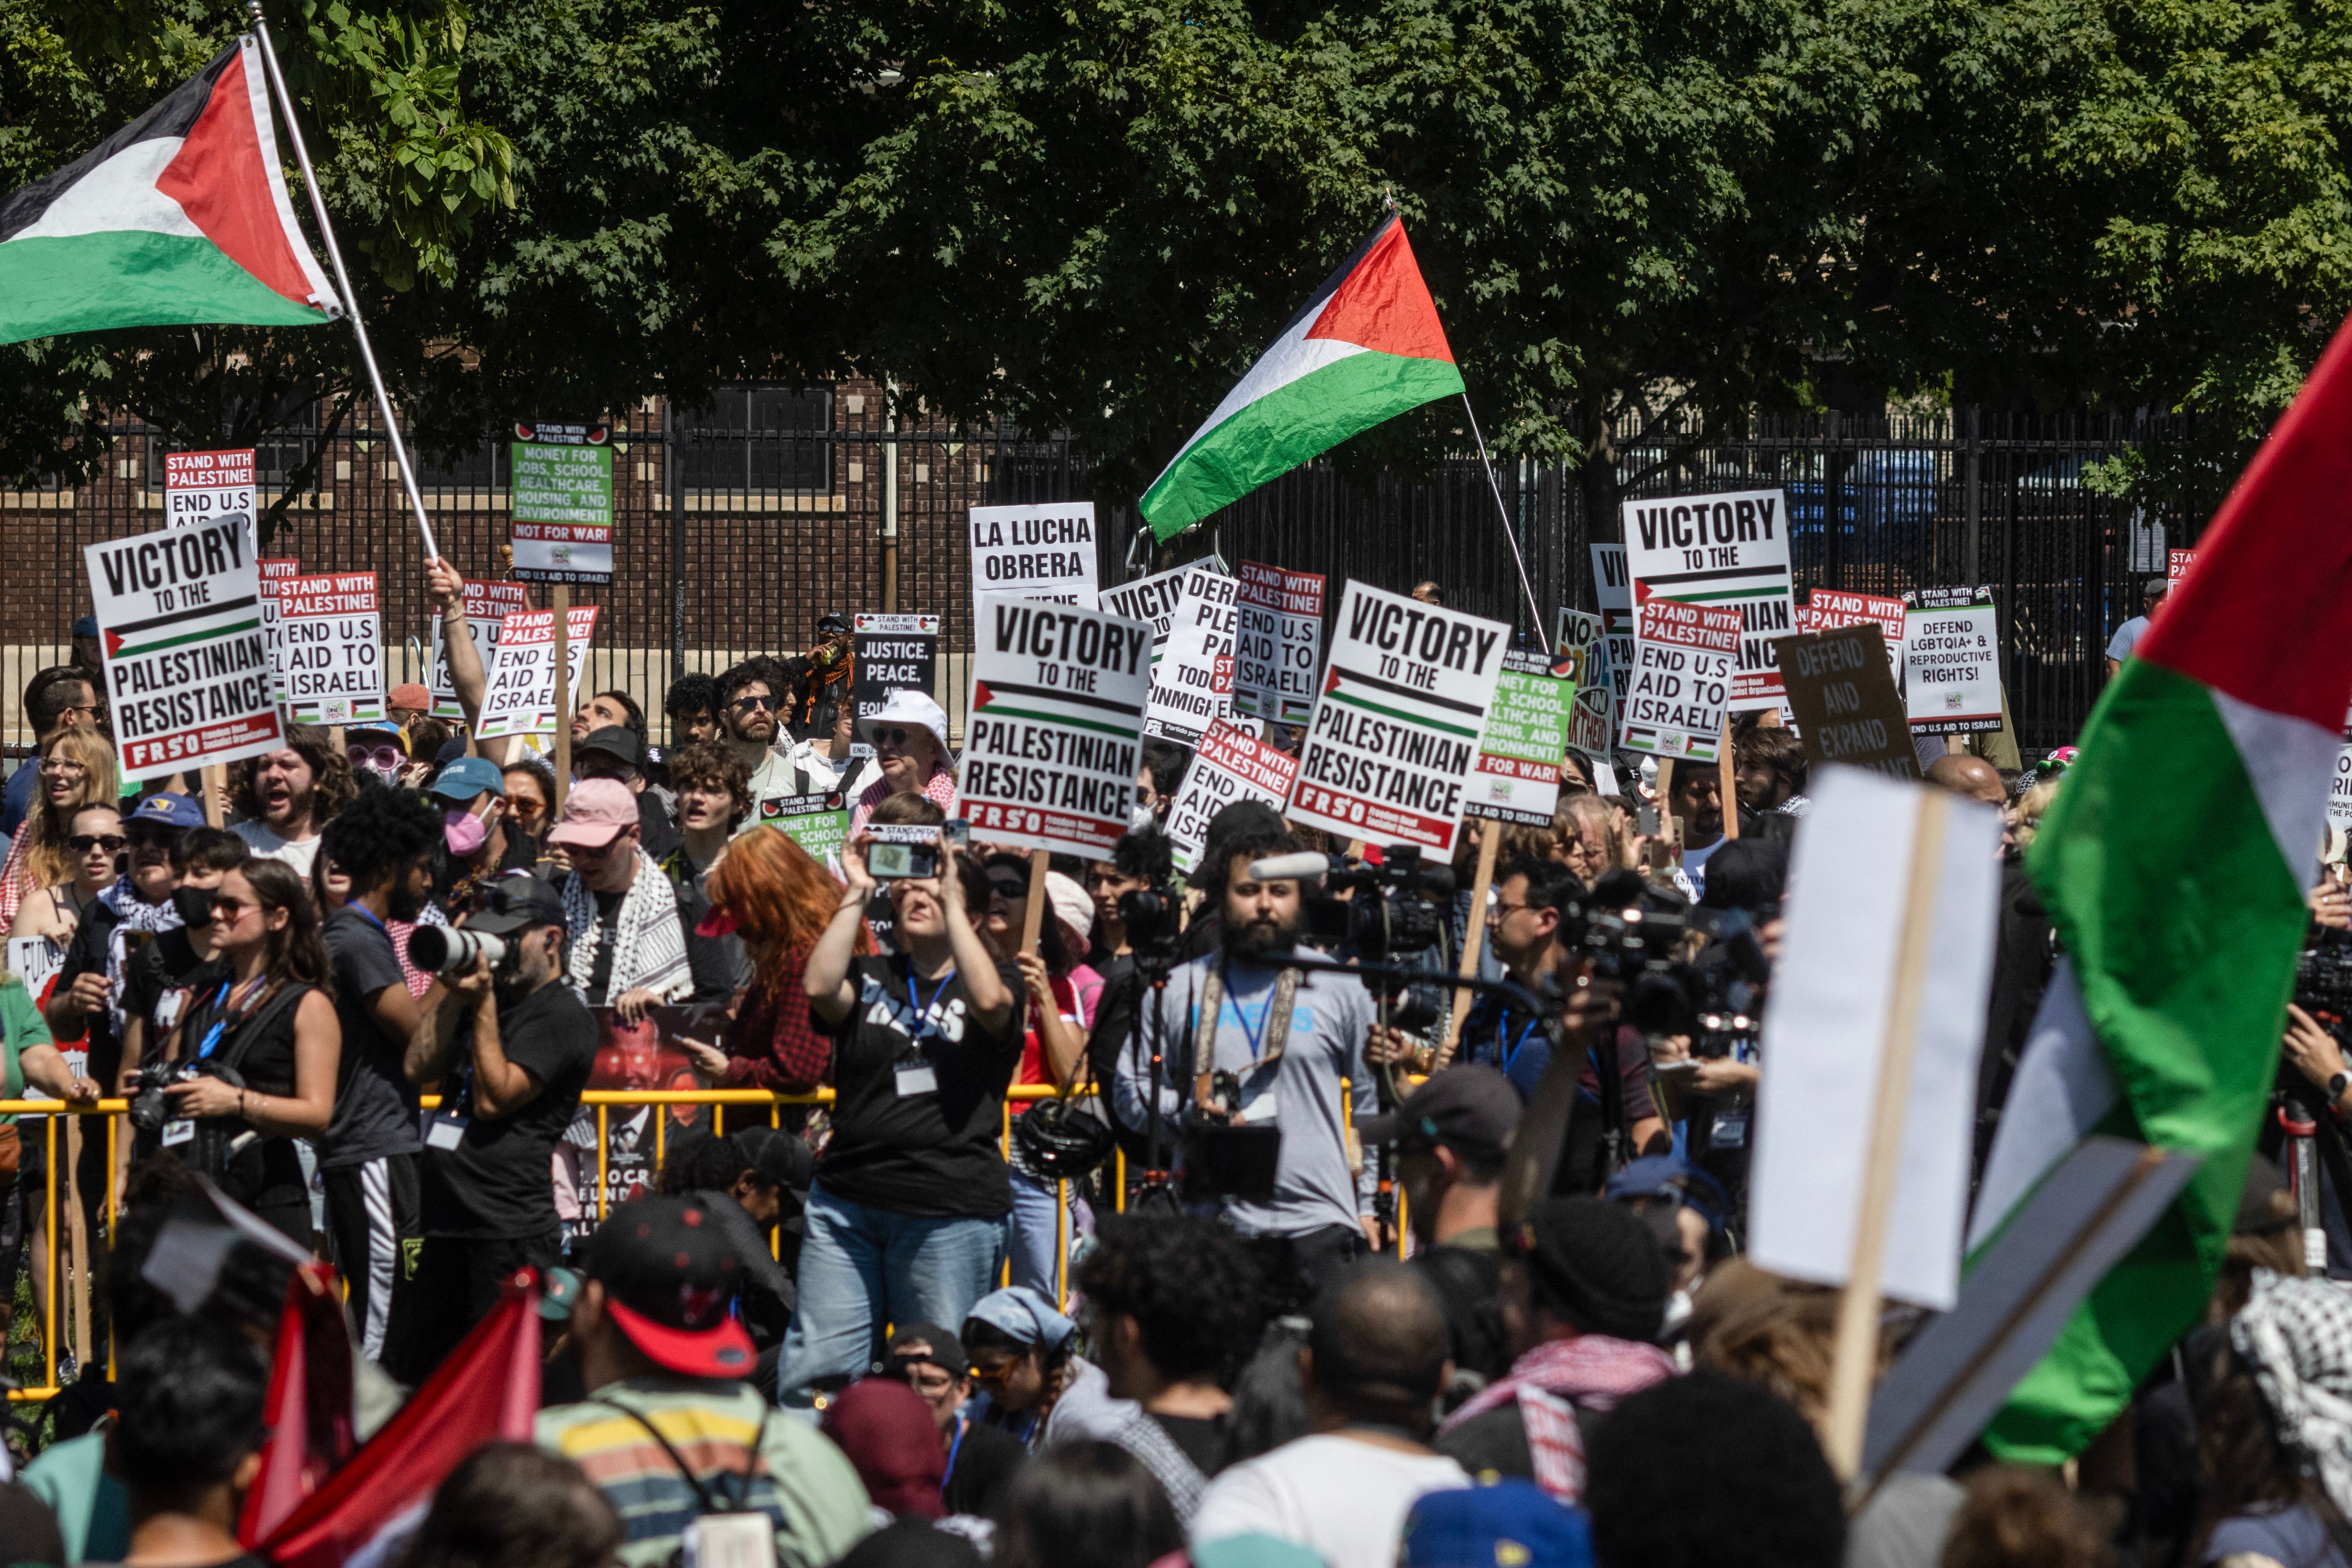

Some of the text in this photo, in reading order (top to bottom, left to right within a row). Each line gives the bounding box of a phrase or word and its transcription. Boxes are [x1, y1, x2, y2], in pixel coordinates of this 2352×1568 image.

[536, 424, 586, 435] STAND WITH
[538, 433, 584, 444] PALESTINE!
[168, 453, 251, 470] STAND WITH
[524, 447, 597, 462] MONEY FOR
[169, 469, 252, 486] PALESTINE!
[174, 492, 249, 512] END U.S
[580, 495, 607, 507] AND
[515, 506, 607, 523] ENVIRONMENT!
[1636, 498, 1776, 551] VICTORY
[515, 524, 607, 541] NOT FOR WAR!
[974, 518, 1092, 548] LA LUCHA
[100, 521, 242, 597] VICTORY
[264, 563, 296, 577] WITH
[985, 552, 1084, 581] OBRERA
[1683, 546, 1739, 570] TO THE
[281, 579, 331, 596] STAND
[336, 576, 374, 592] WITH
[515, 570, 609, 583] END U.S AID TO ISRAEL!
[1241, 565, 1321, 594] STAND WITH
[153, 581, 211, 614] TO THE
[282, 593, 375, 614] PALESTINE!
[489, 585, 524, 601] WITH
[1241, 582, 1319, 613] PALESTINE!
[1922, 588, 1972, 599] STAND WITH
[1925, 598, 1970, 608] PALESTINE!
[1646, 603, 1697, 624] STAND
[1703, 612, 1741, 631] WITH
[1812, 593, 1904, 618] STAND WITH
[288, 619, 372, 643] END U.S
[504, 613, 554, 628] STAND
[1153, 616, 1171, 635] TO
[1241, 609, 1313, 642] END U.S
[1561, 613, 1591, 646] NO
[1923, 621, 1973, 635] DEFEND
[995, 604, 1147, 676] VICTORY
[1348, 592, 1498, 676] VICTORY
[1643, 620, 1738, 650] PALESTINE!
[1911, 635, 1987, 651] LGBTQIA+ &
[290, 646, 331, 670] AID
[342, 643, 376, 666] TO
[500, 650, 539, 667] END
[860, 642, 929, 660] JUSTICE,
[1239, 633, 1313, 669] AID TO
[1528, 653, 1551, 666] WITH
[1641, 647, 1685, 672] END
[1694, 655, 1728, 678] U.S
[1796, 637, 1865, 677] DEFEND
[1910, 651, 1992, 666] REPRODUCTIVE
[113, 634, 265, 697] PALESTINIAN
[866, 664, 921, 683] PEACE,
[1037, 661, 1098, 693] TO THE
[1238, 658, 1311, 695] ISRAEL!
[1379, 654, 1440, 691] TO THE
[1502, 658, 1546, 675] ALESTINE!
[1922, 667, 1979, 683] RIGHTS!
[291, 670, 378, 695] ISRAEL!
[493, 669, 533, 690] AID
[1530, 680, 1559, 697] FOR
[1636, 672, 1680, 698] AID
[1693, 679, 1725, 705] TO
[120, 673, 273, 738] RESISTANCE
[1822, 681, 1860, 715] AND
[1632, 697, 1721, 731] ISRAEL!
[1943, 723, 1956, 731] AID
[1972, 720, 2001, 730] ISRAEL!
[1165, 724, 1187, 734] Partido
[1315, 704, 1472, 776] PALESTINIAN
[1530, 729, 1561, 746] AND
[1818, 718, 1889, 758] EXPAND
[970, 720, 1135, 778] PALESTINIAN
[1208, 723, 1296, 777] STAND WITH
[1201, 738, 1290, 794] PALESTINE!
[1486, 757, 1557, 782] FOR WAR!
[965, 760, 1130, 820] RESISTANCE
[1193, 764, 1234, 797] END
[1303, 743, 1462, 818] RESISTANCE
[780, 795, 826, 807] STAND WITH
[783, 803, 824, 815] PALESTINE!
[815, 816, 837, 827] FOR
[1465, 803, 1550, 827] U.S AID TO ISRAEL!
